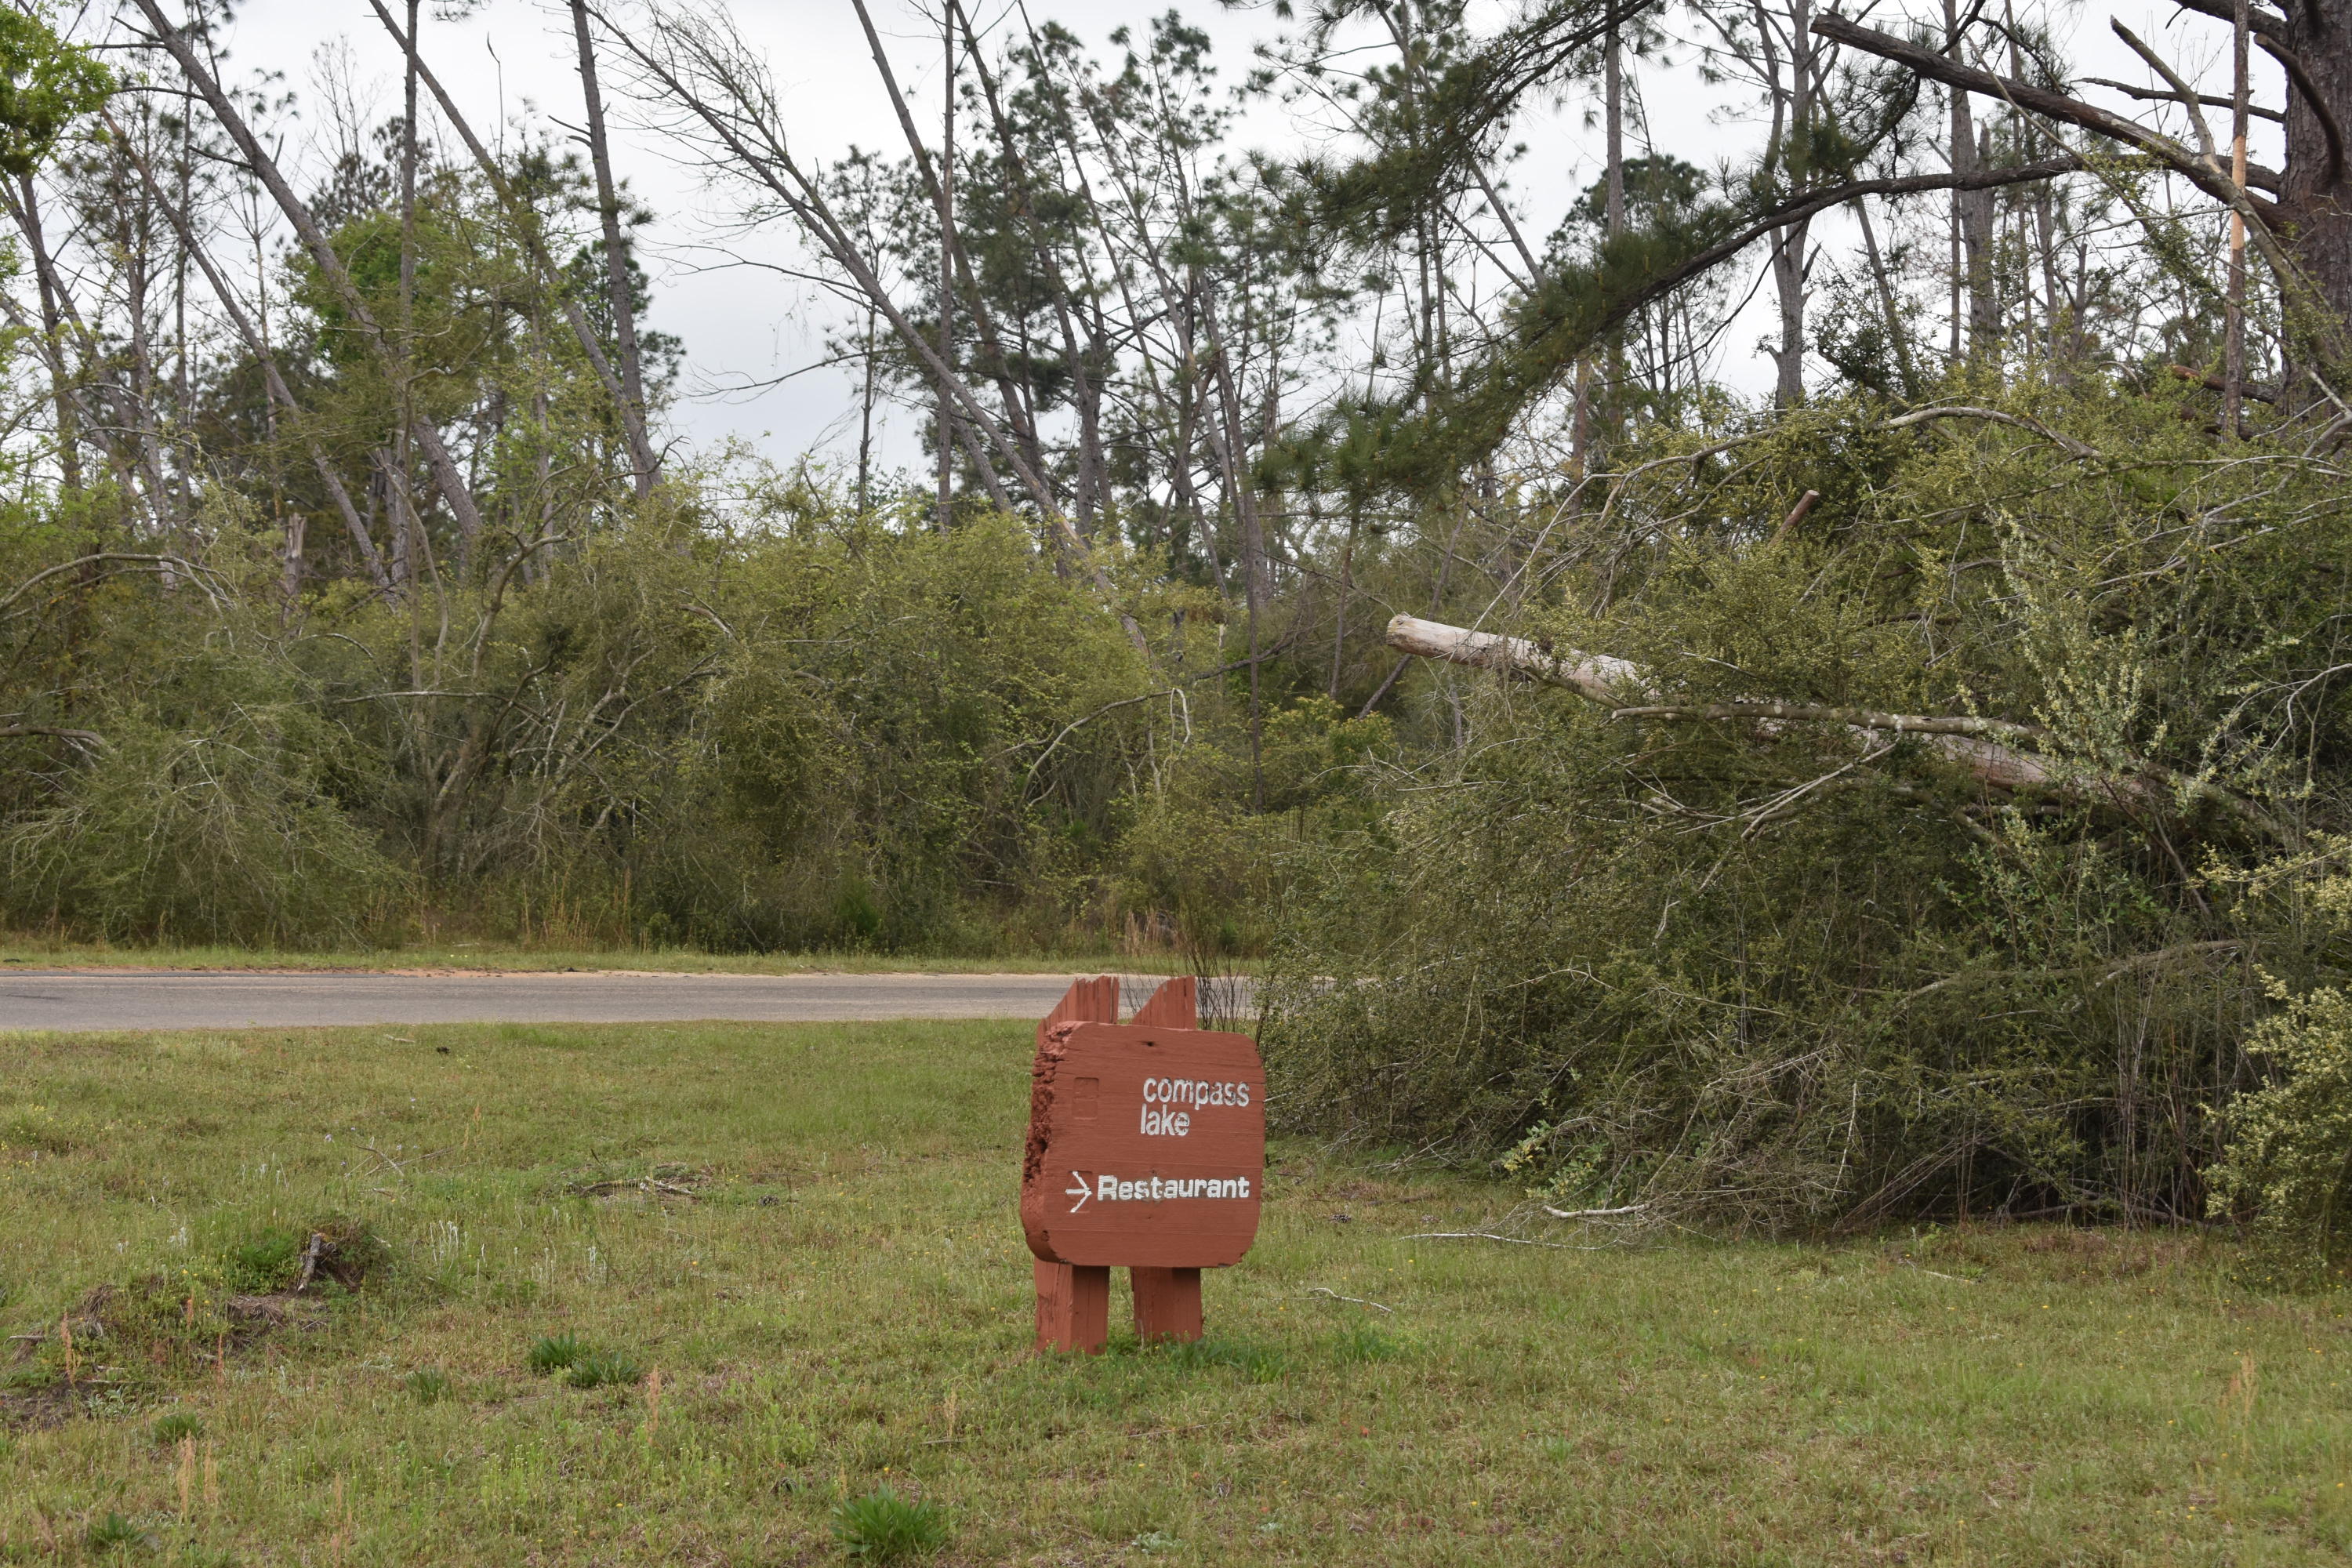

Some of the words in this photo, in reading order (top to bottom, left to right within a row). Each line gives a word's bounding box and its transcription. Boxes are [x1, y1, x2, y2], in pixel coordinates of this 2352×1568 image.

[1143, 1077, 1250, 1110] compass
[1140, 1103, 1190, 1137] lake
[1097, 1174, 1250, 1201] Restaurant
